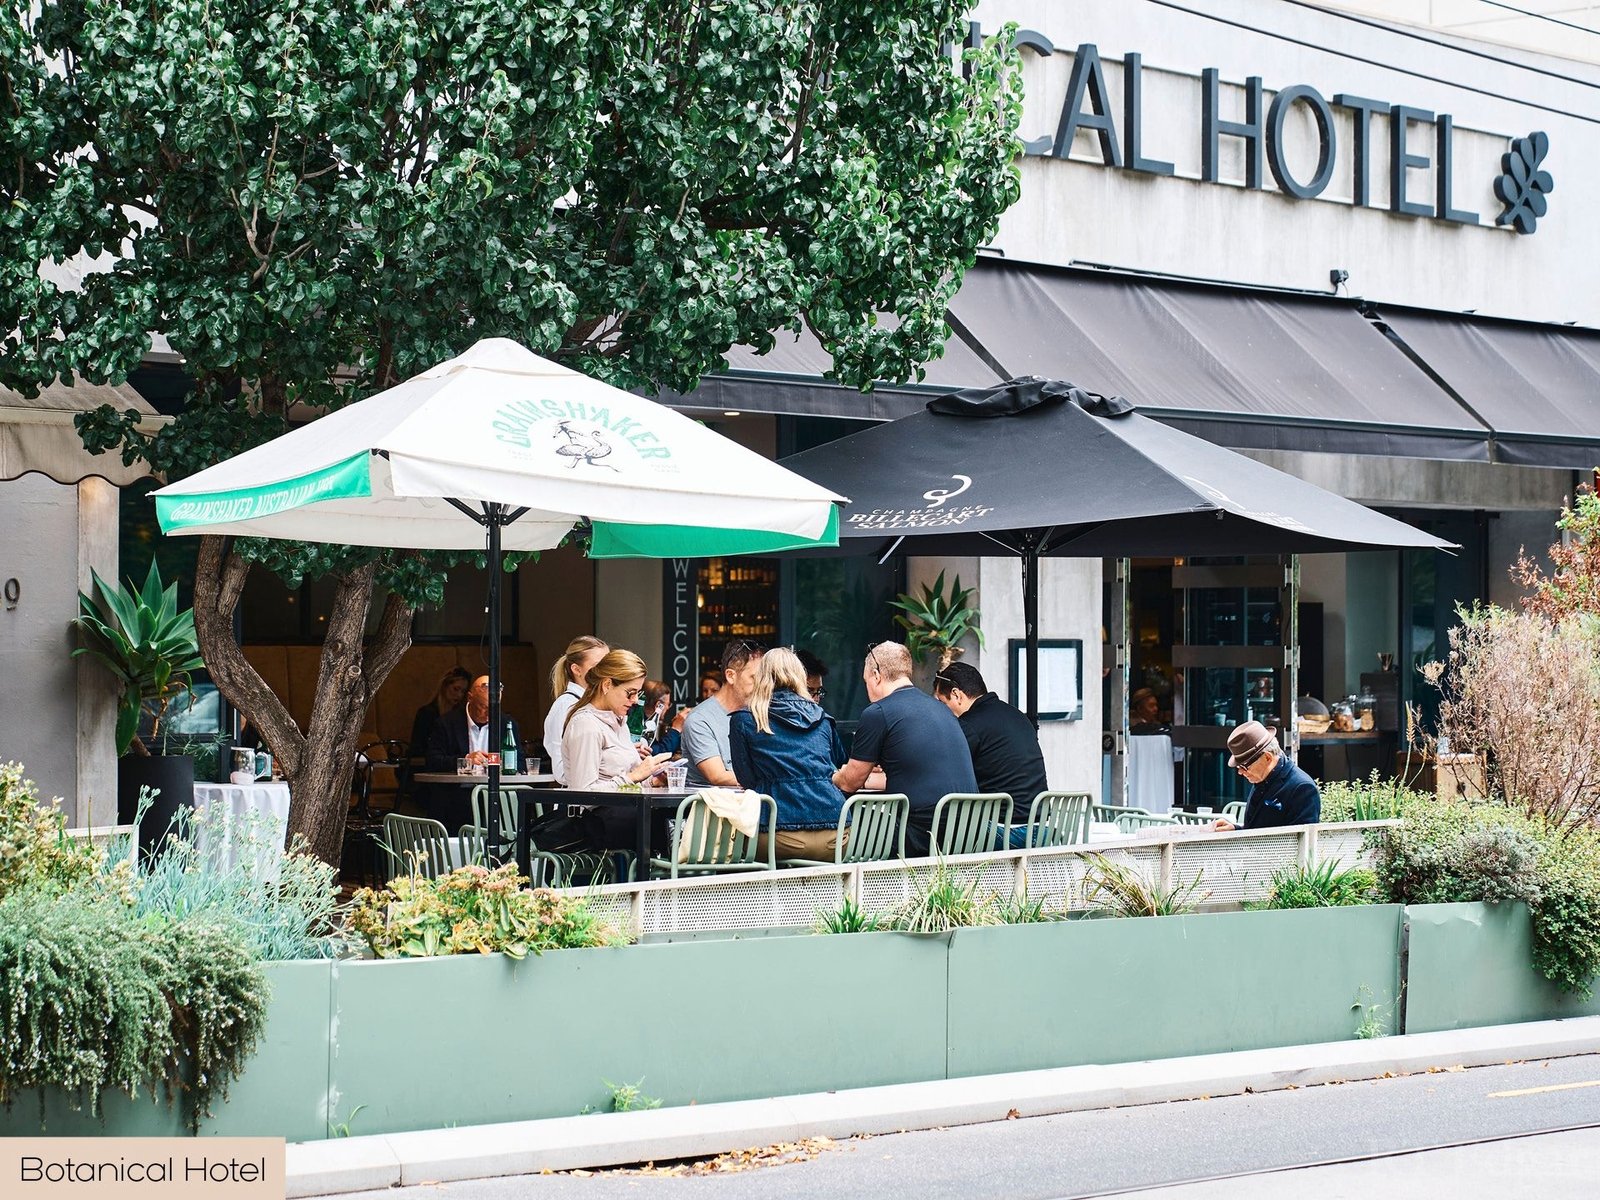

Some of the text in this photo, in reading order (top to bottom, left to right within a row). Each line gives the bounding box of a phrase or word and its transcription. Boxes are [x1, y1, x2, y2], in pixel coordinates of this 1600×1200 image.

[1201, 67, 1480, 225] HOTEL
[846, 507, 994, 523] BILLECART
[872, 504, 984, 514] CHAMPAGNE
[853, 517, 968, 529] SALMON
